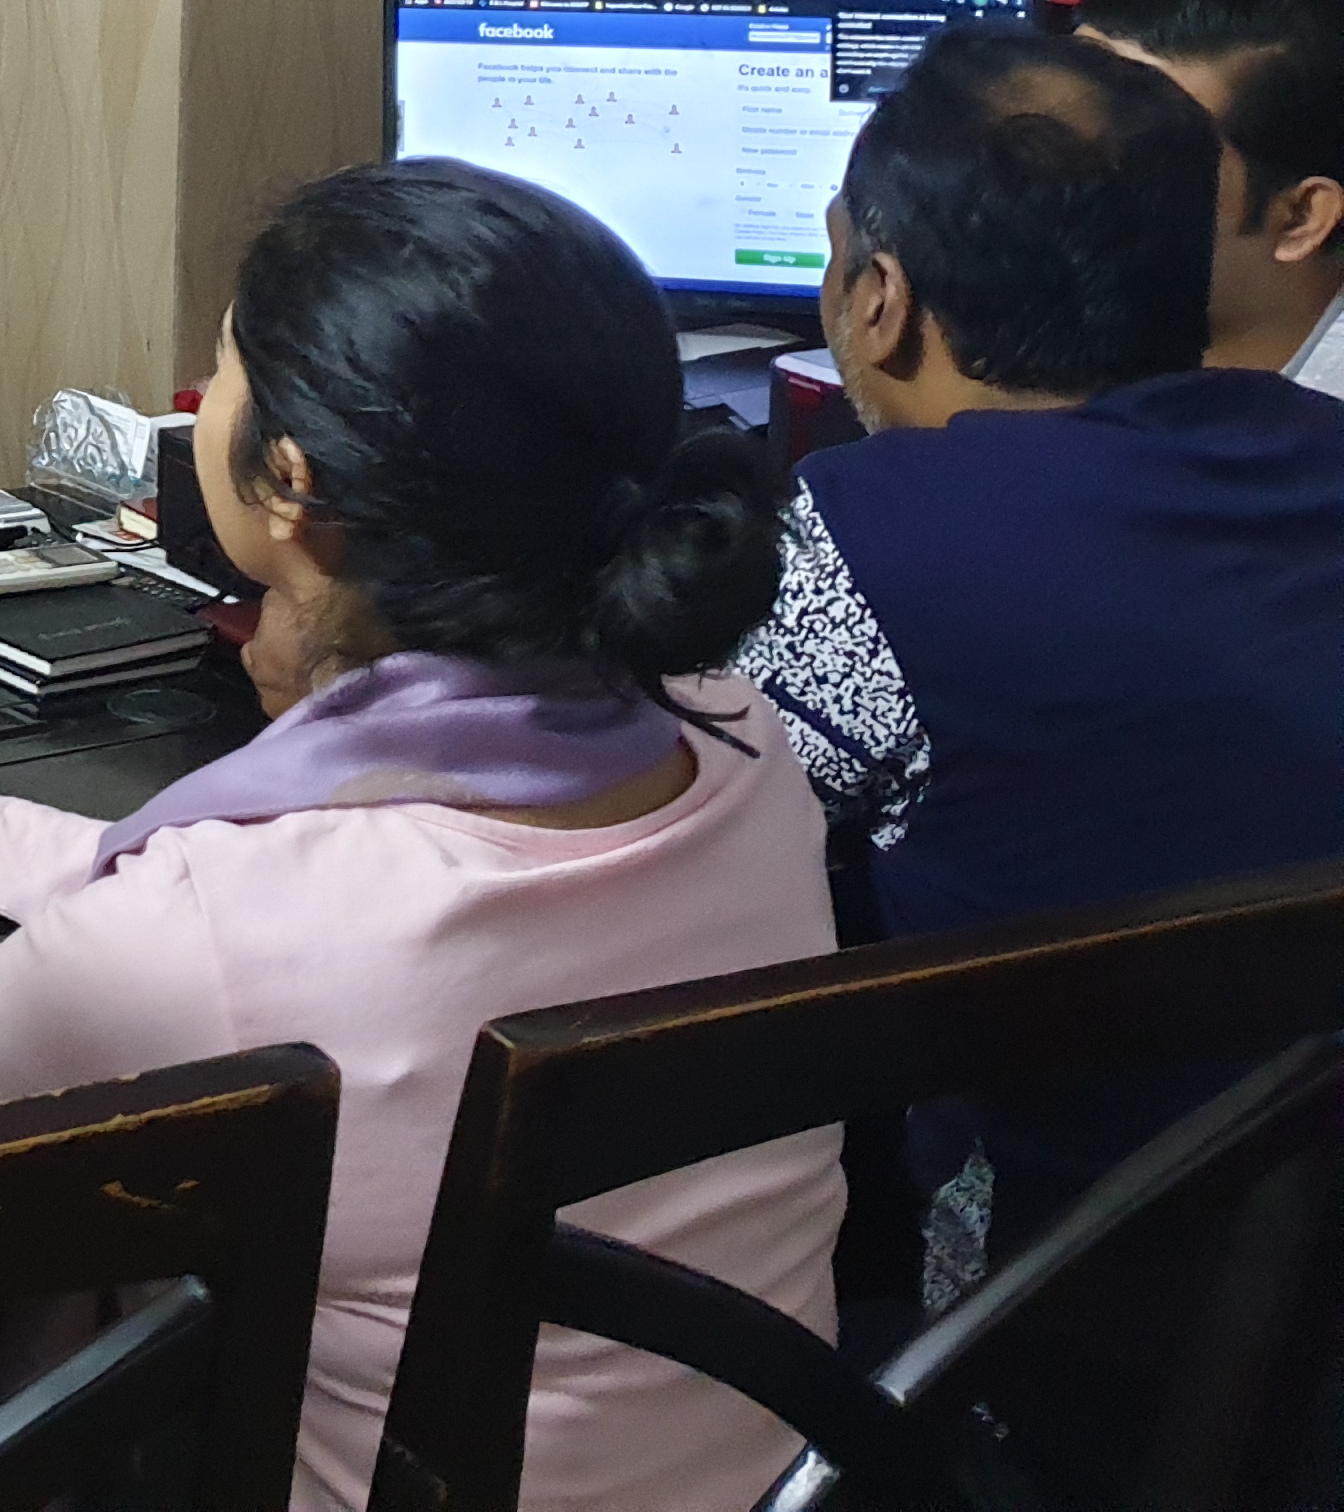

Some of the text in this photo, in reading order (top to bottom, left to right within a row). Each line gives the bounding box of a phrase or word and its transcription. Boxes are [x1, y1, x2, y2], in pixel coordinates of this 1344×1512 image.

[478, 22, 554, 39] facebook
[738, 64, 790, 77] Create
[795, 68, 814, 78] an
